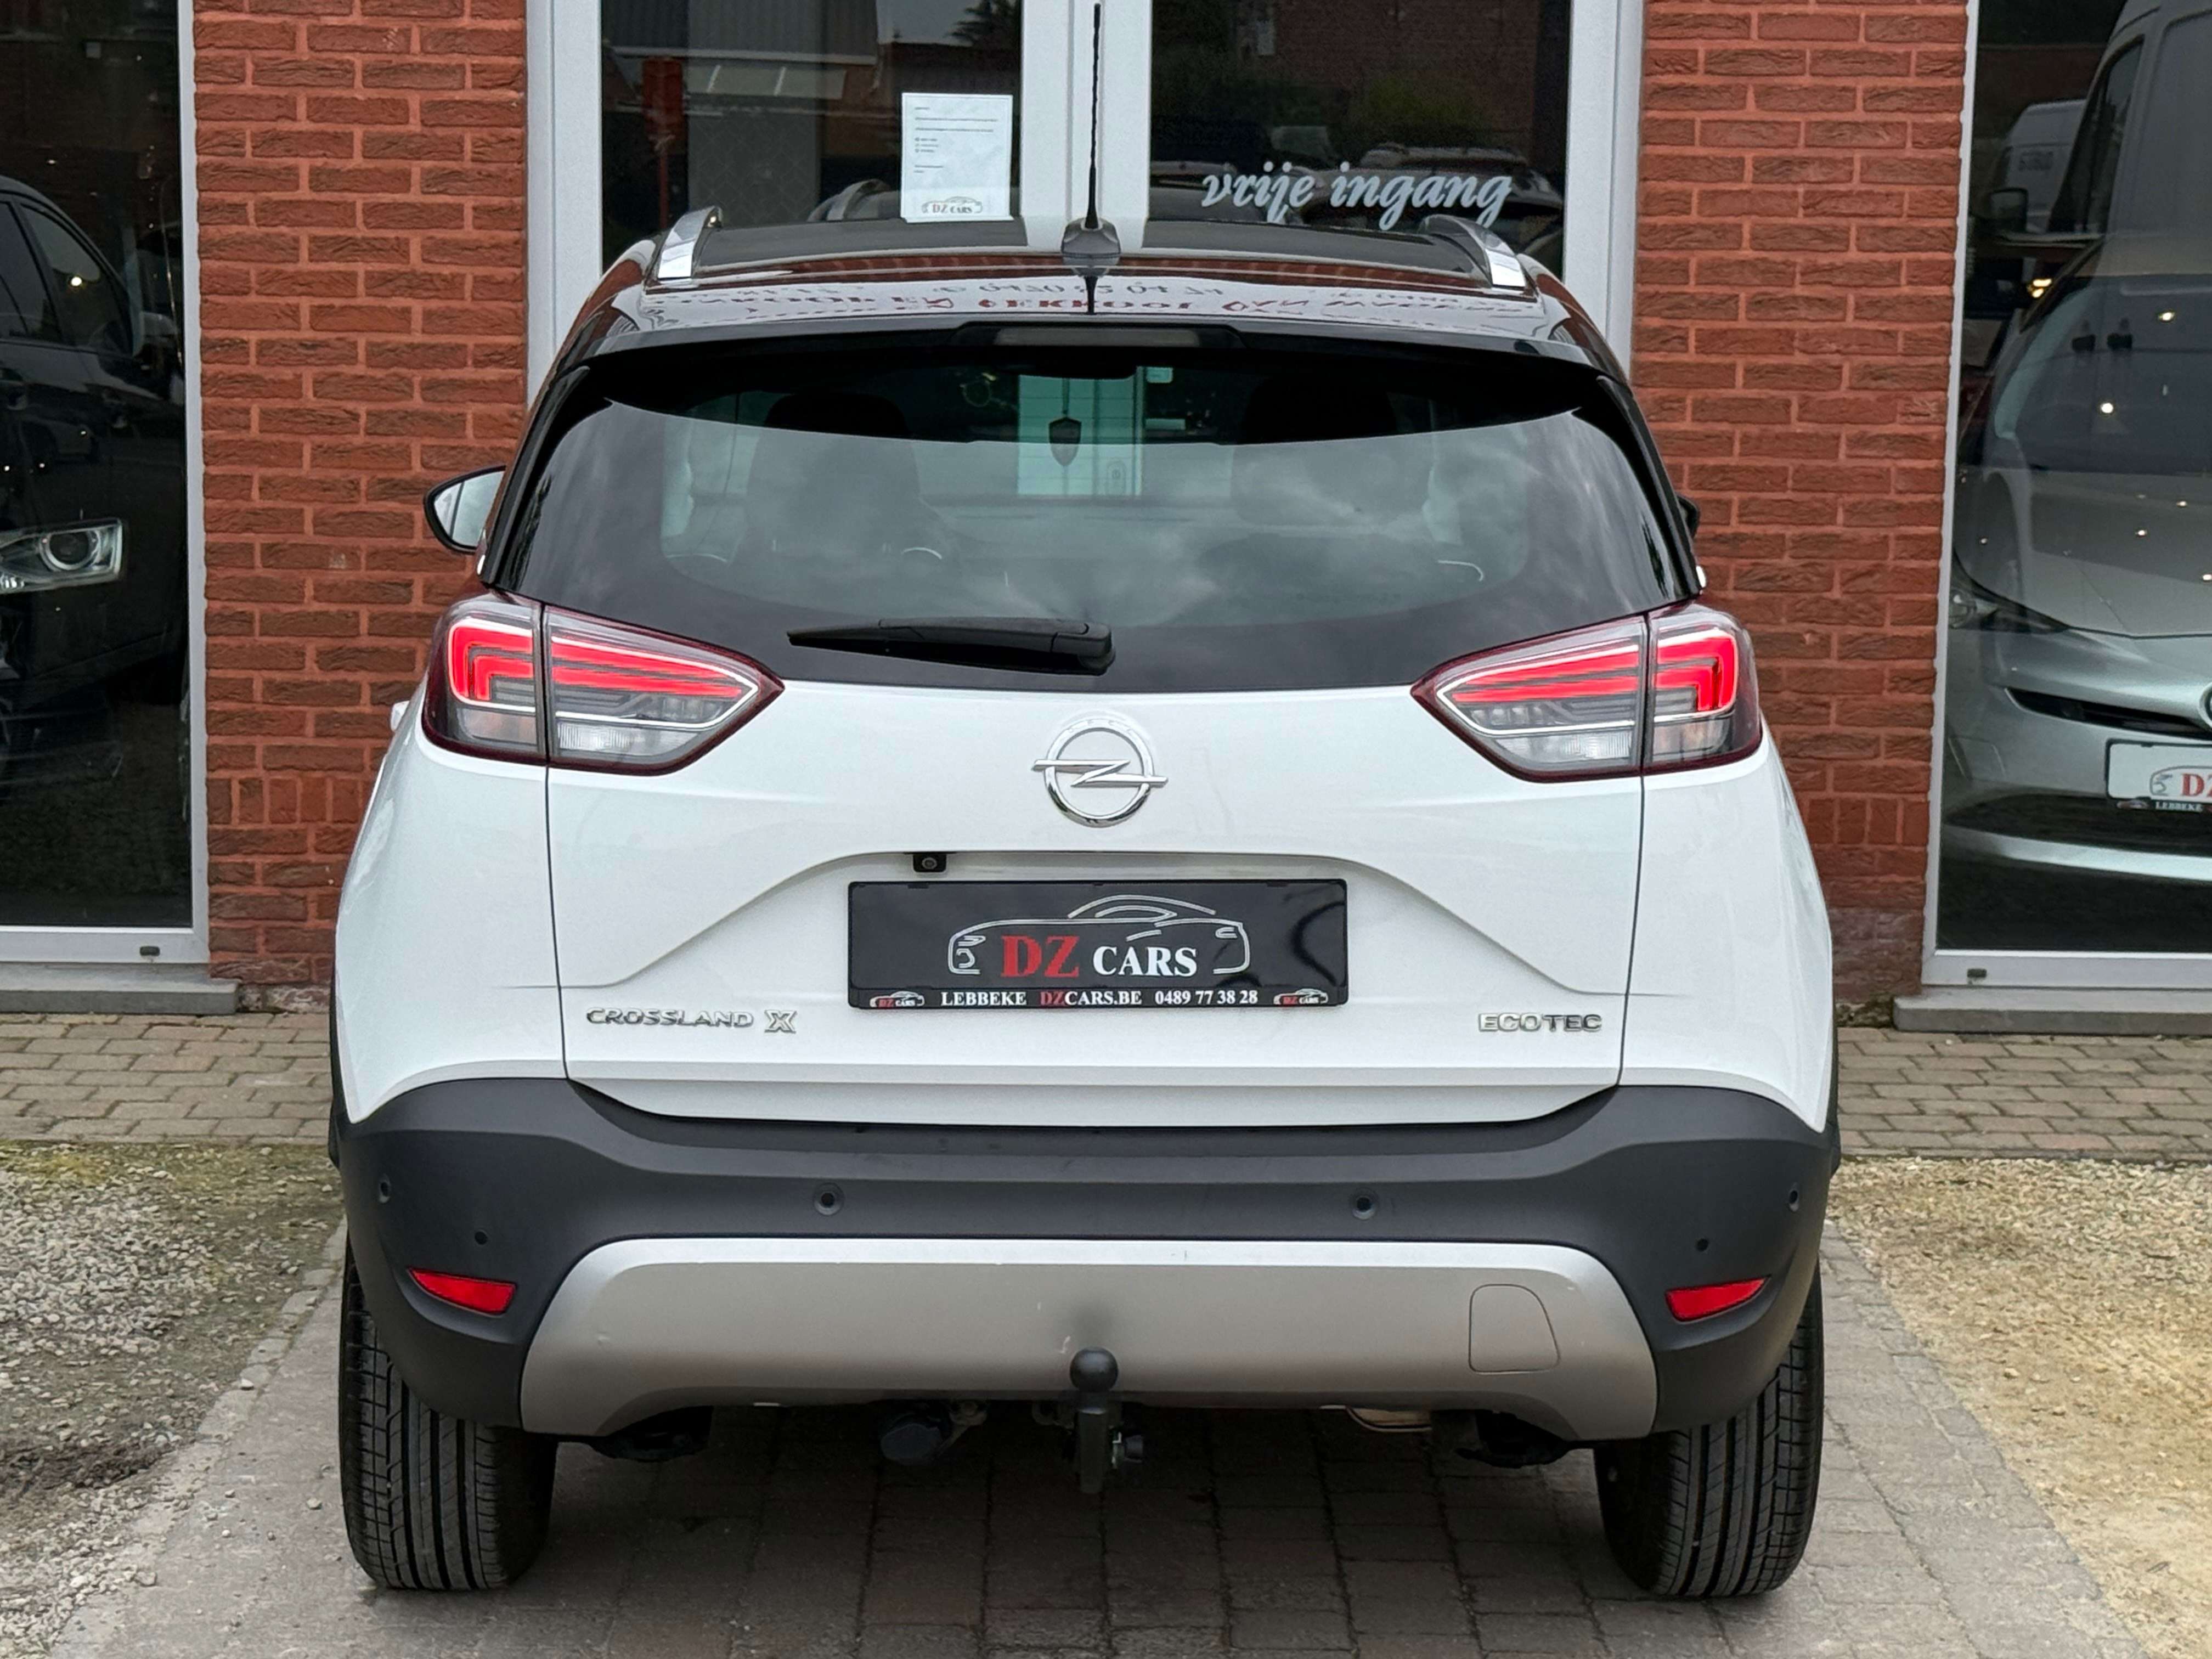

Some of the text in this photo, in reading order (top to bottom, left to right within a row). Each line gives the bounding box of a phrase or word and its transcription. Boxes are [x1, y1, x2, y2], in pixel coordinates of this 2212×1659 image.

[1201, 161, 1513, 231] vrije ingang
[2181, 772, 2212, 798] D
[1000, 934, 1198, 978] DZ CARS
[940, 990, 1259, 1006] LEBBEKE DZCARS.BE 0489 77 38 28
[586, 1006, 798, 1034] CROSSLAND X
[1479, 1012, 1602, 1032] ECOTEC
